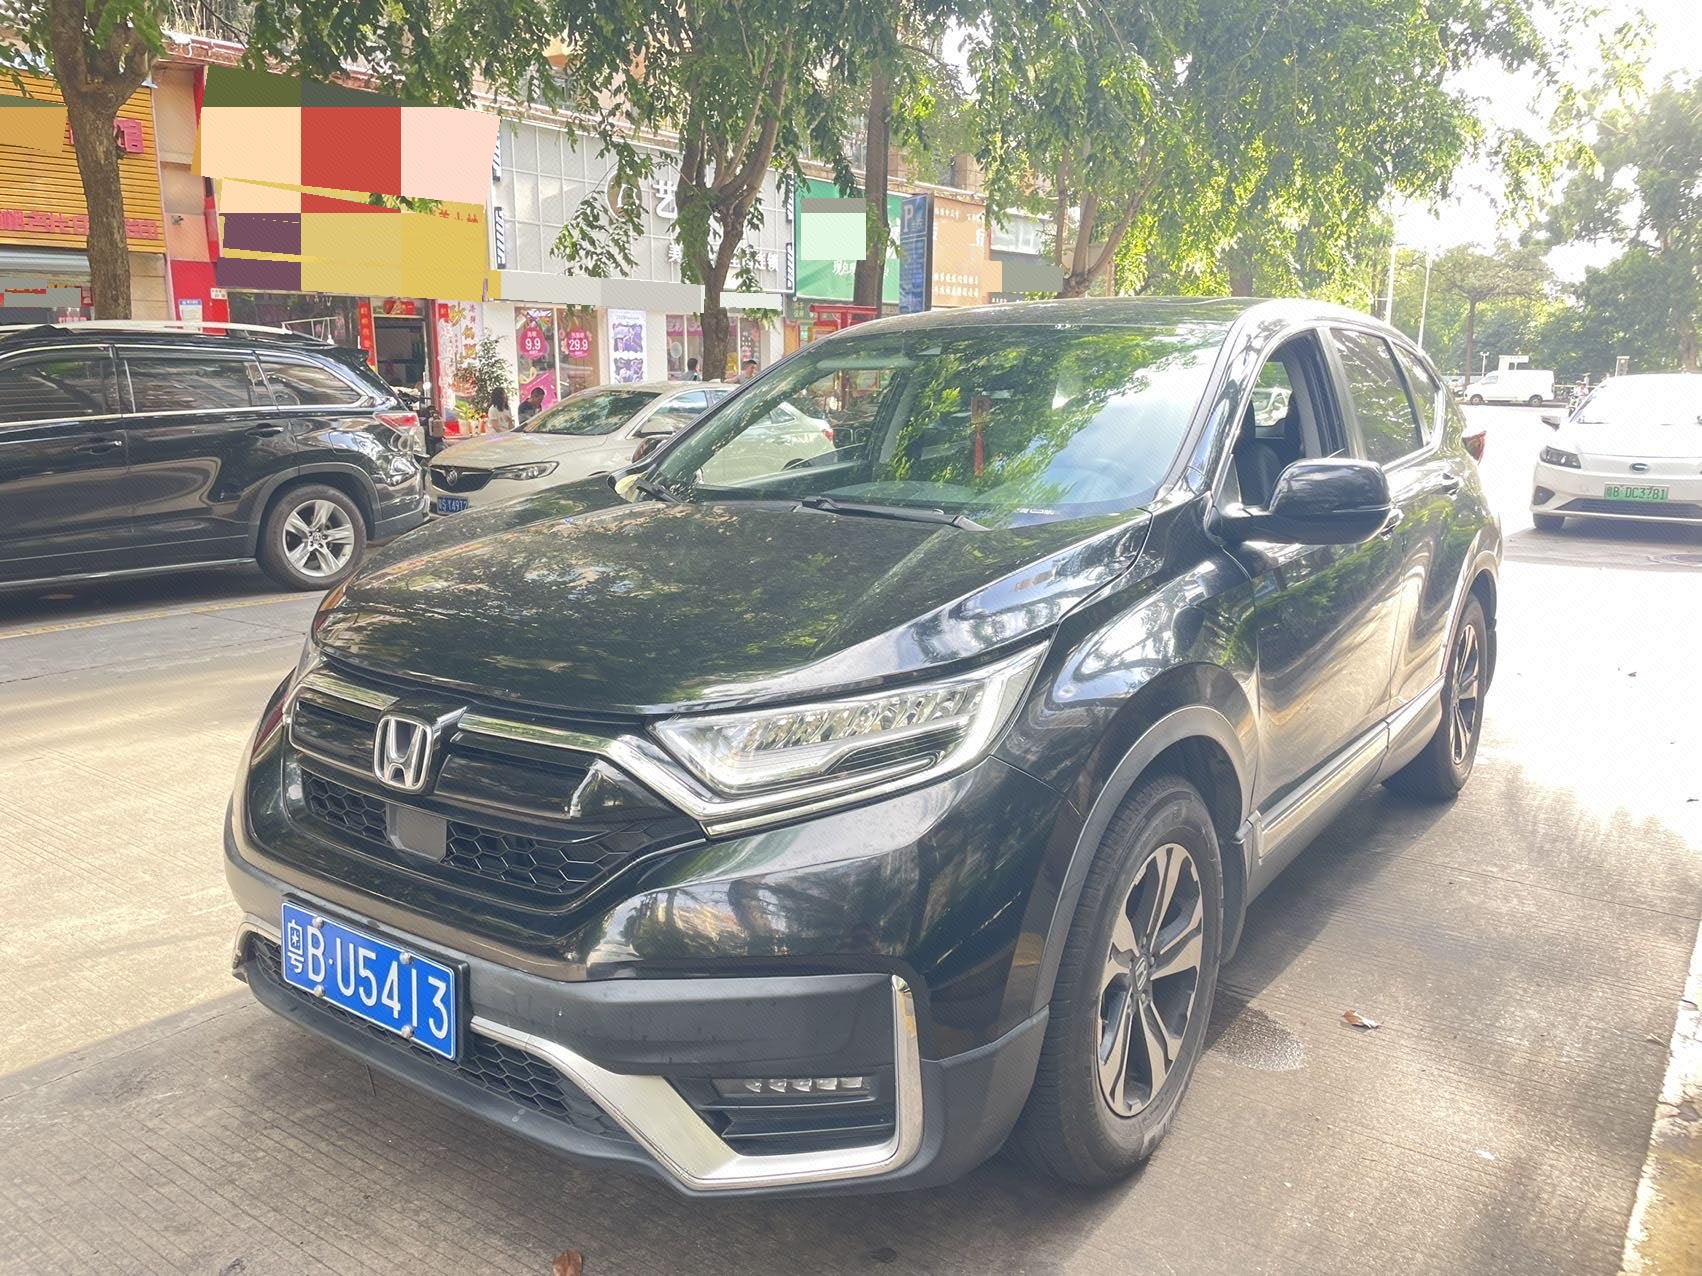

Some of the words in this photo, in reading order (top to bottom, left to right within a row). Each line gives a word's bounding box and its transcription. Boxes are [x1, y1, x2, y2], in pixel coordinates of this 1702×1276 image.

[903, 204, 914, 232] P
[525, 337, 541, 350] 9.9
[287, 919, 448, 1039] 粤B·U5413
